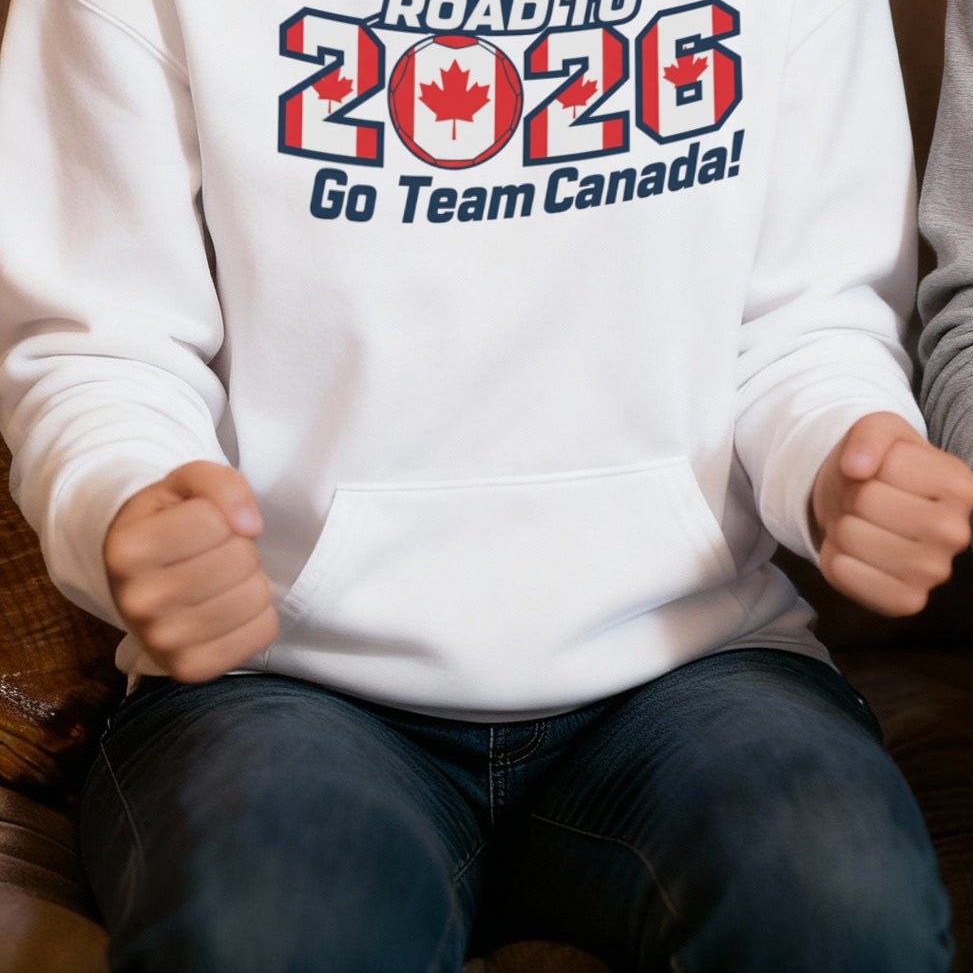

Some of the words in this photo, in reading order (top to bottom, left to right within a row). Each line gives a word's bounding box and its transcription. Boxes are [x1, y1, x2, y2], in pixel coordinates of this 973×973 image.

[309, 167, 378, 222] Go
[398, 174, 536, 223] Team
[543, 129, 745, 214] Canada!
